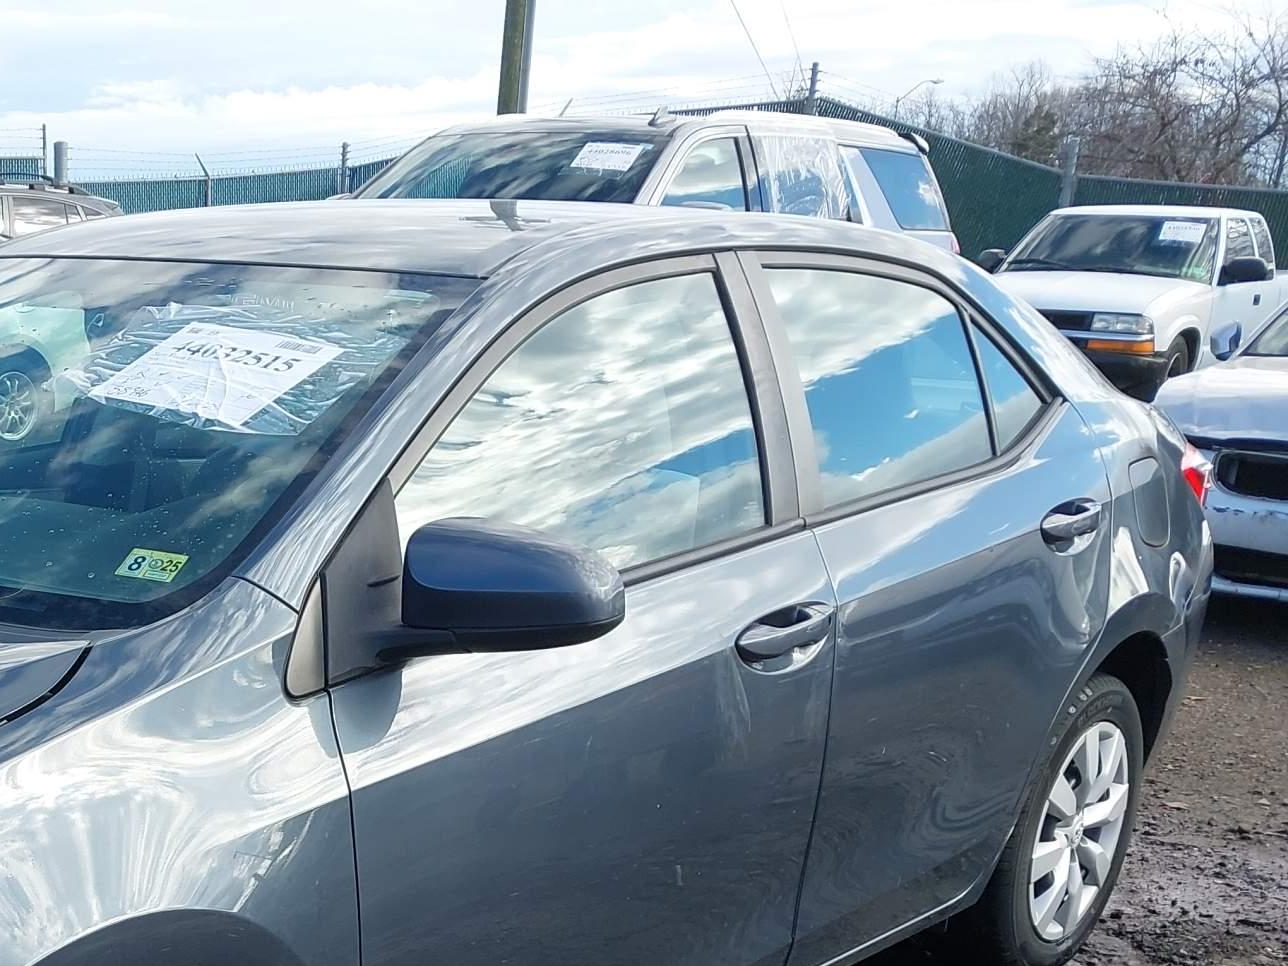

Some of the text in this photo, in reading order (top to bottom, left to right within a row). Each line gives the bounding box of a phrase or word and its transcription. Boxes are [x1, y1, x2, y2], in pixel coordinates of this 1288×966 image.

[172, 341, 302, 372] 44032515
[127, 556, 182, 573] 8 25
